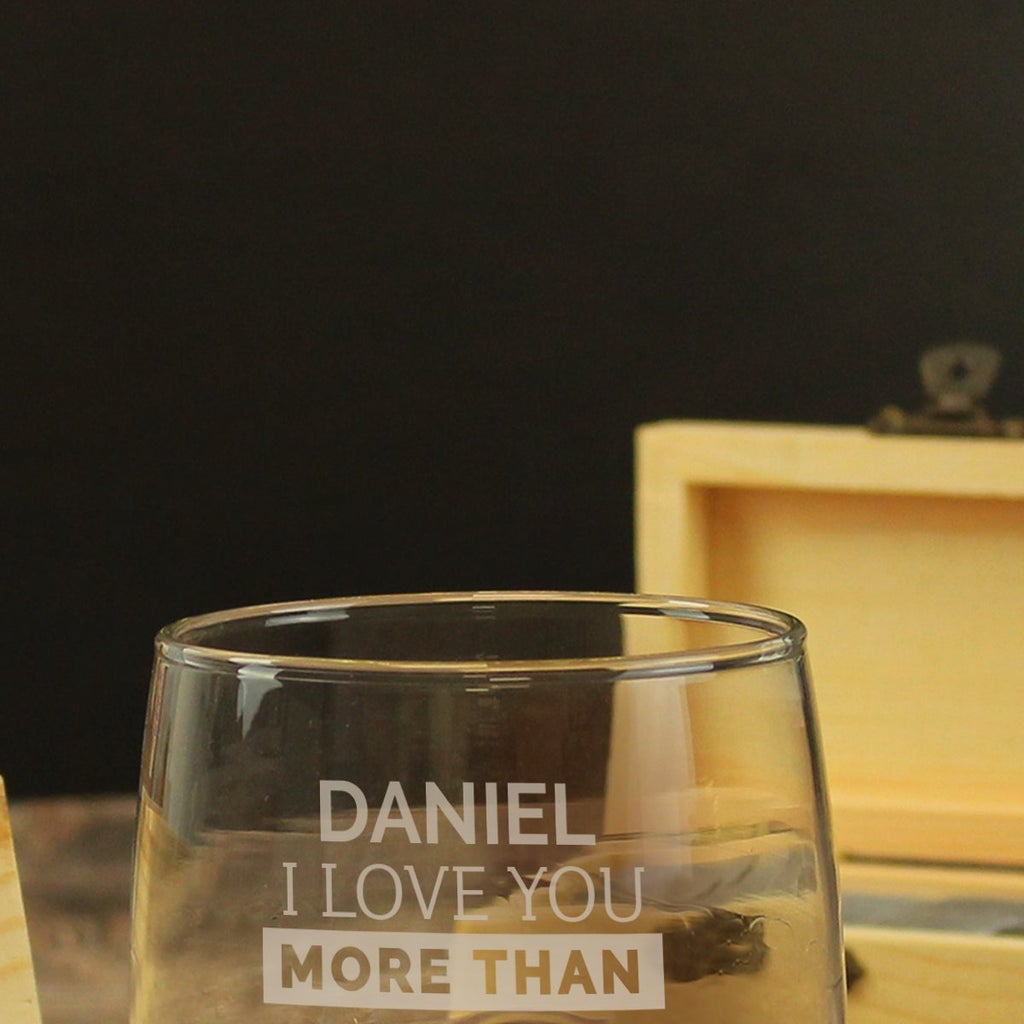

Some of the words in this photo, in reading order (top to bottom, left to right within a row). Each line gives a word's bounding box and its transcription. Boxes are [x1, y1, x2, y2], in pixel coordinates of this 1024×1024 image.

[319, 779, 596, 846] DANIEL
[282, 862, 298, 916] I
[321, 863, 488, 921] LOVE
[507, 866, 644, 923] YOU
[280, 944, 451, 995] MORE
[472, 948, 640, 996] THAN
